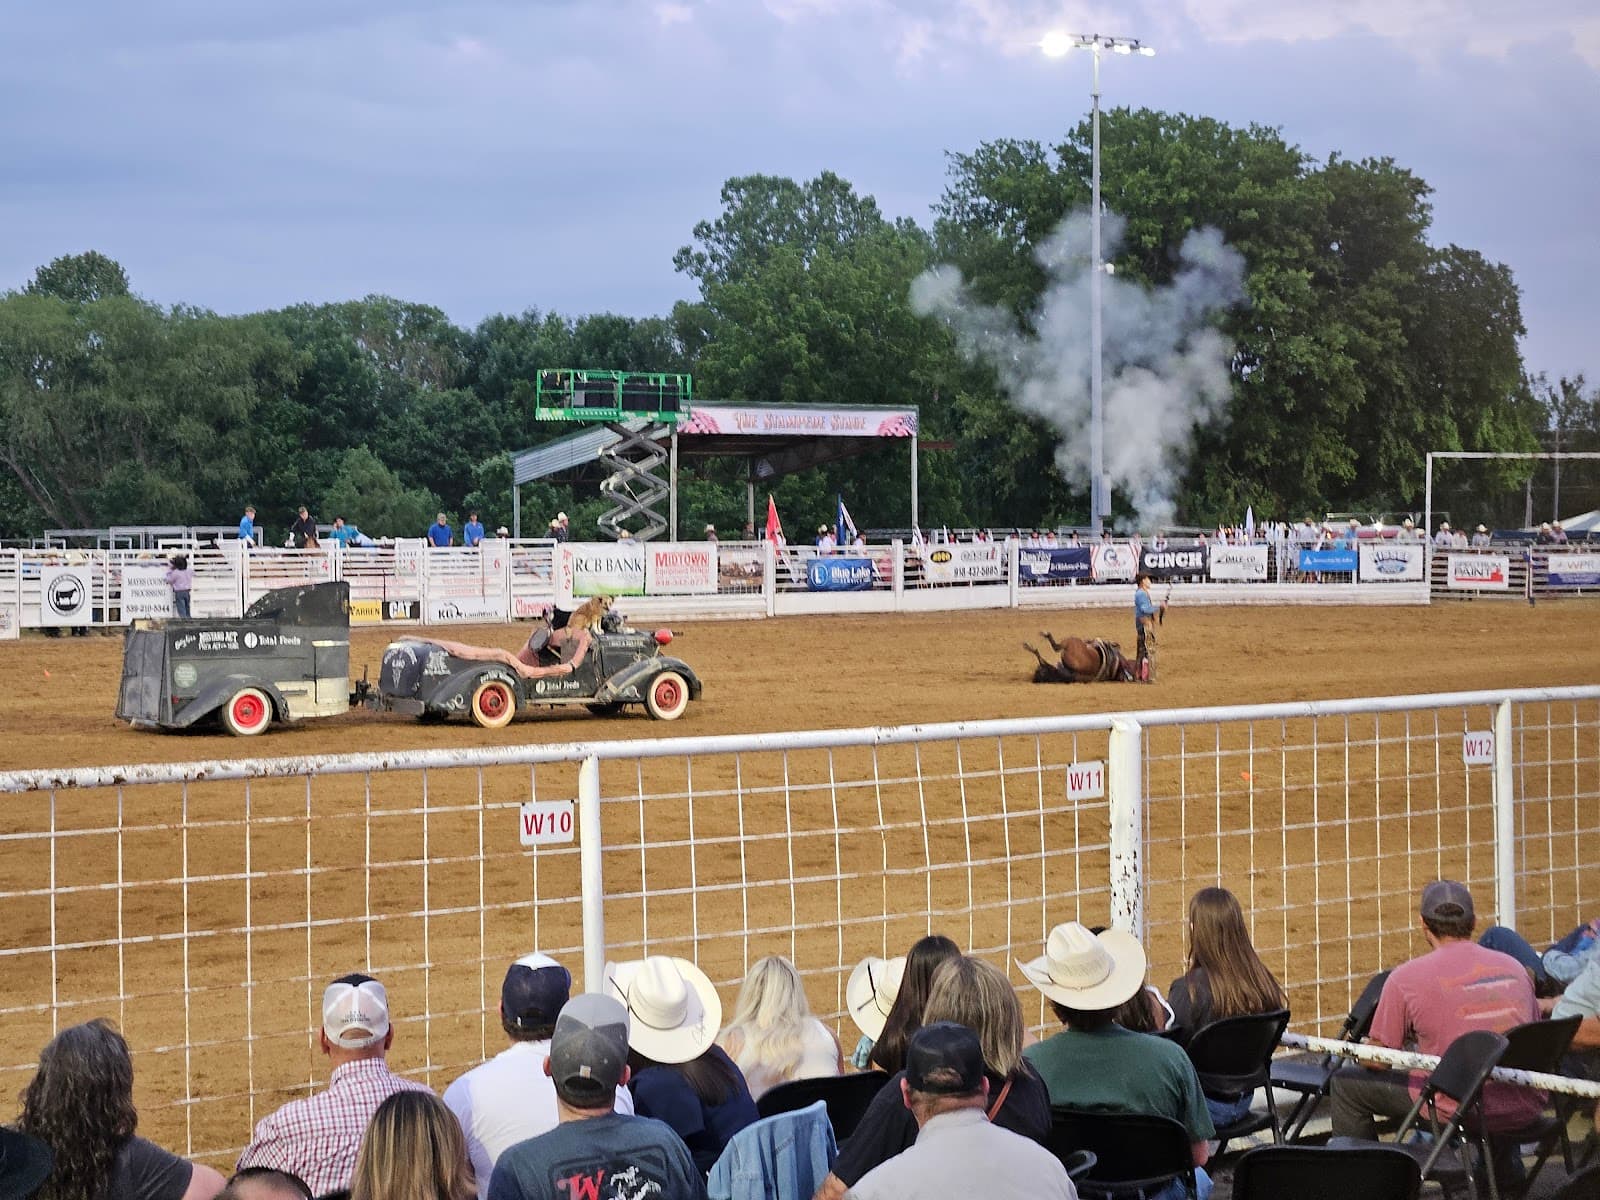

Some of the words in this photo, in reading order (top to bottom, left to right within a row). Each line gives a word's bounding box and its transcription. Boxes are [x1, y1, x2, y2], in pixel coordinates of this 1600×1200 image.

[575, 557, 602, 572] RCB
[606, 557, 642, 572] BANK
[656, 551, 709, 567] MIDTOWN
[1144, 552, 1203, 569] CINCH
[832, 566, 850, 579] Blue
[852, 565, 870, 579] Lake
[389, 601, 412, 619] CAT
[259, 635, 277, 646] Total
[280, 635, 301, 645] Feeds
[1466, 739, 1491, 757] W12
[1070, 770, 1101, 791] W11
[524, 811, 572, 835] W10
